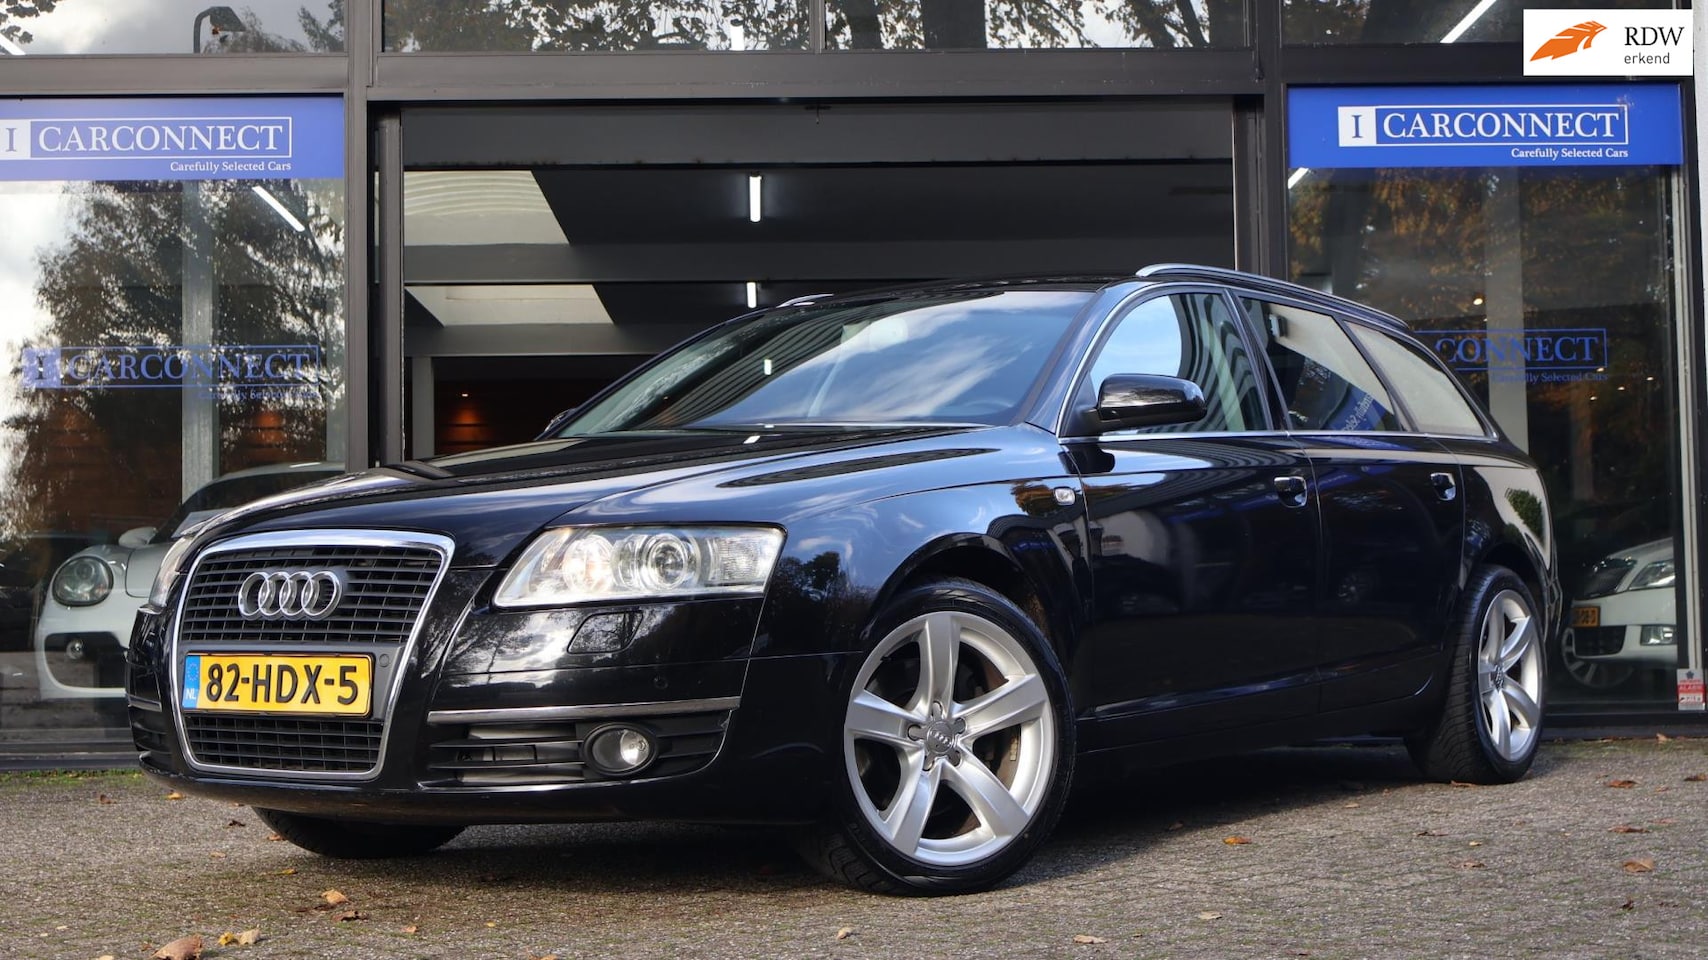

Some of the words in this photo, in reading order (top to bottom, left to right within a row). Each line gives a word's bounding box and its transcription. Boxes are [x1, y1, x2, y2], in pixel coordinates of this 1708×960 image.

[1351, 115, 1363, 138] I
[1383, 112, 1619, 138] CARCONNECT
[5, 128, 17, 152] I
[38, 125, 283, 151] CARCONNECT
[170, 161, 219, 174] Carefully
[222, 161, 265, 172] Selected
[267, 161, 291, 171] Cars
[1511, 148, 1558, 161] Carefully
[1561, 148, 1602, 158] Selected
[1605, 148, 1628, 158] Cars
[69, 353, 310, 380] CARCONNECT
[186, 689, 197, 699] NL
[206, 663, 358, 705] 82-HDX-5
